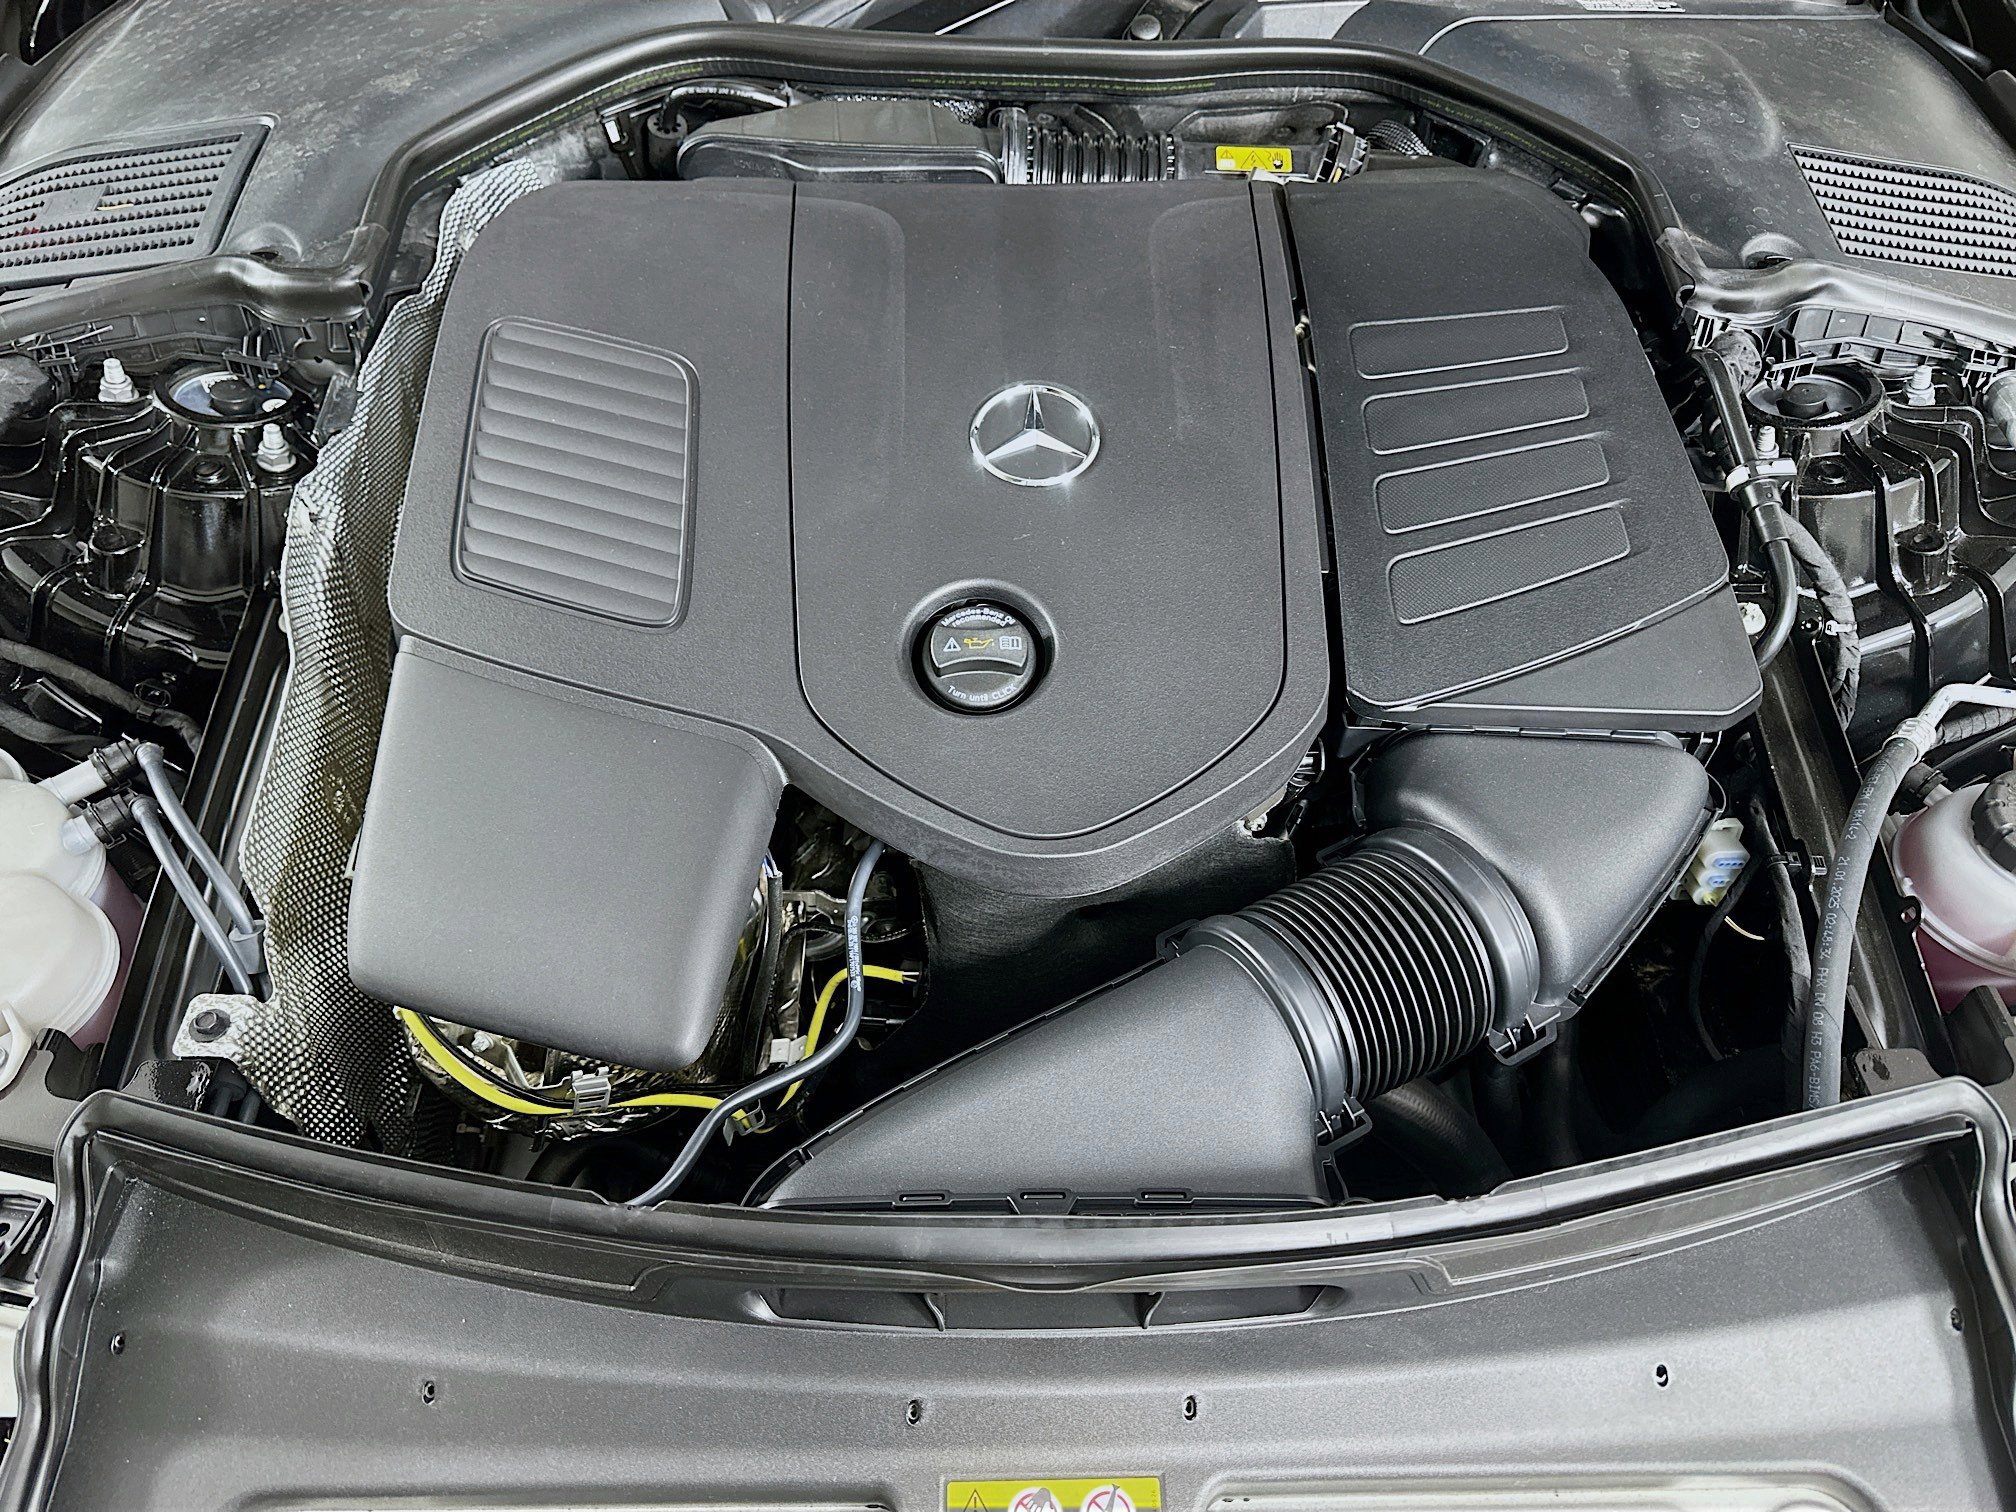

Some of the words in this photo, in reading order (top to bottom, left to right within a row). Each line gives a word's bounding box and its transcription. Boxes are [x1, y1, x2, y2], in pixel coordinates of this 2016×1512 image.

[941, 608, 1004, 626] Mercedes-Benz
[952, 614, 1006, 627] recommended
[947, 685, 966, 699] Turn
[991, 683, 1017, 699] CLICK
[1828, 857, 1850, 908] 21.01.2025
[1820, 913, 1837, 960] 02:48:34
[1811, 1012, 1823, 1026] 08
[1810, 1032, 1822, 1046] H3
